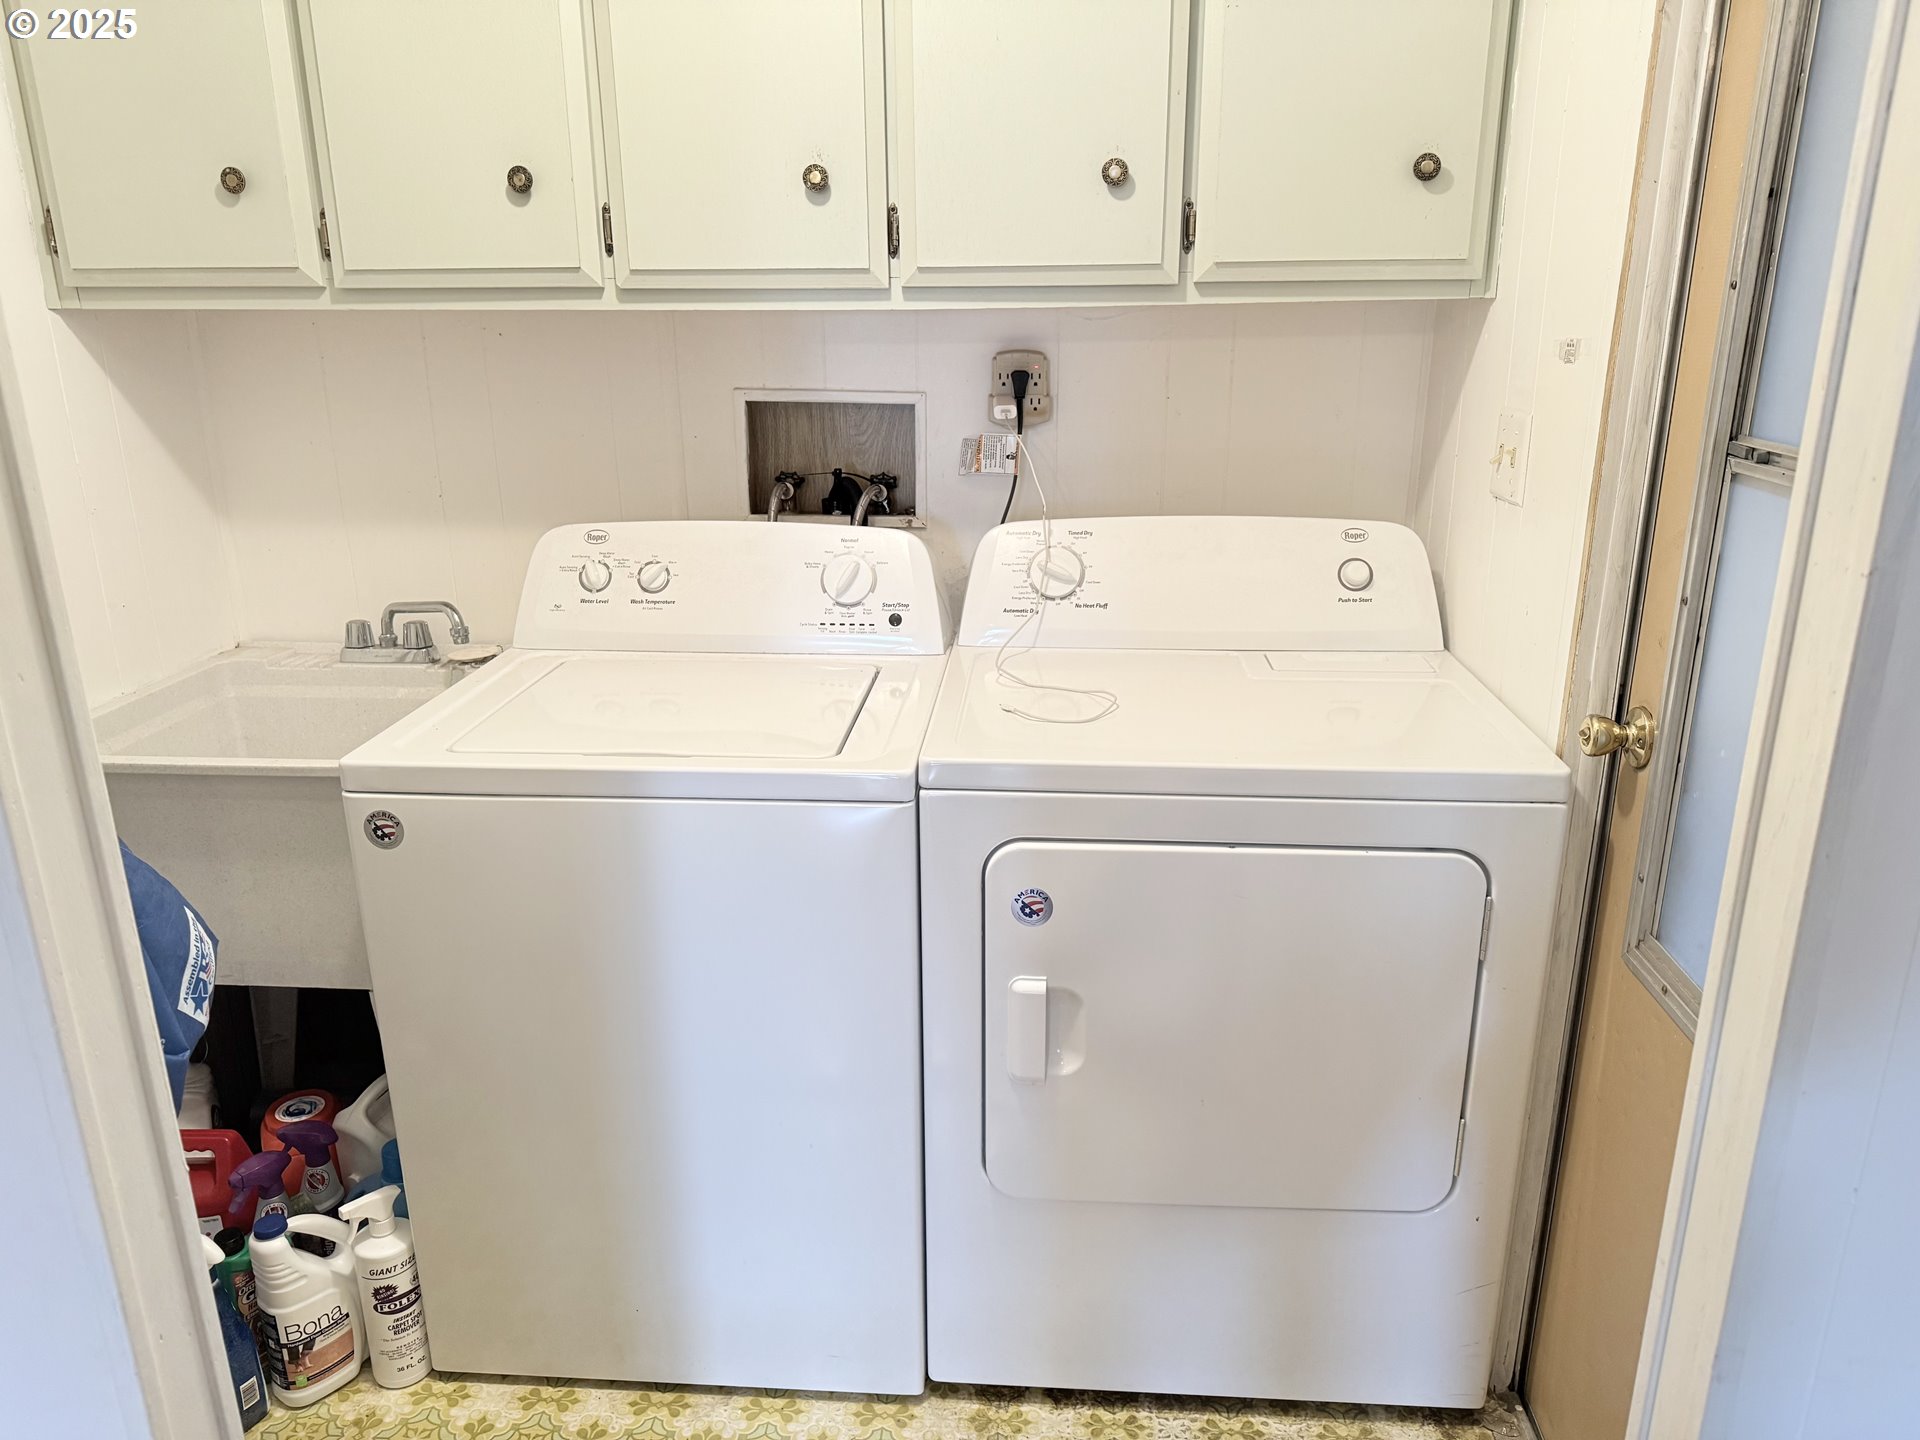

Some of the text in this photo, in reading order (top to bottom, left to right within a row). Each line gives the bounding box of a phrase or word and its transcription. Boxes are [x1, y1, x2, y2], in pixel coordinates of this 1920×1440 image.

[586, 532, 608, 542] Roper
[1344, 531, 1366, 541] Roper
[1029, 607, 1039, 615] Dy
[366, 811, 400, 827] AMERICA
[1014, 889, 1049, 904] AMERICA
[183, 946, 200, 1005] Assembled
[194, 935, 200, 944] in
[369, 1264, 398, 1276] GIANT
[378, 1289, 421, 1313] FOLEX
[284, 1305, 343, 1342] Bona
[388, 1319, 410, 1331] CARPET
[411, 1310, 423, 1323] SPOT
[393, 1309, 416, 1323] INSTANT
[393, 1319, 420, 1336] REMOVER
